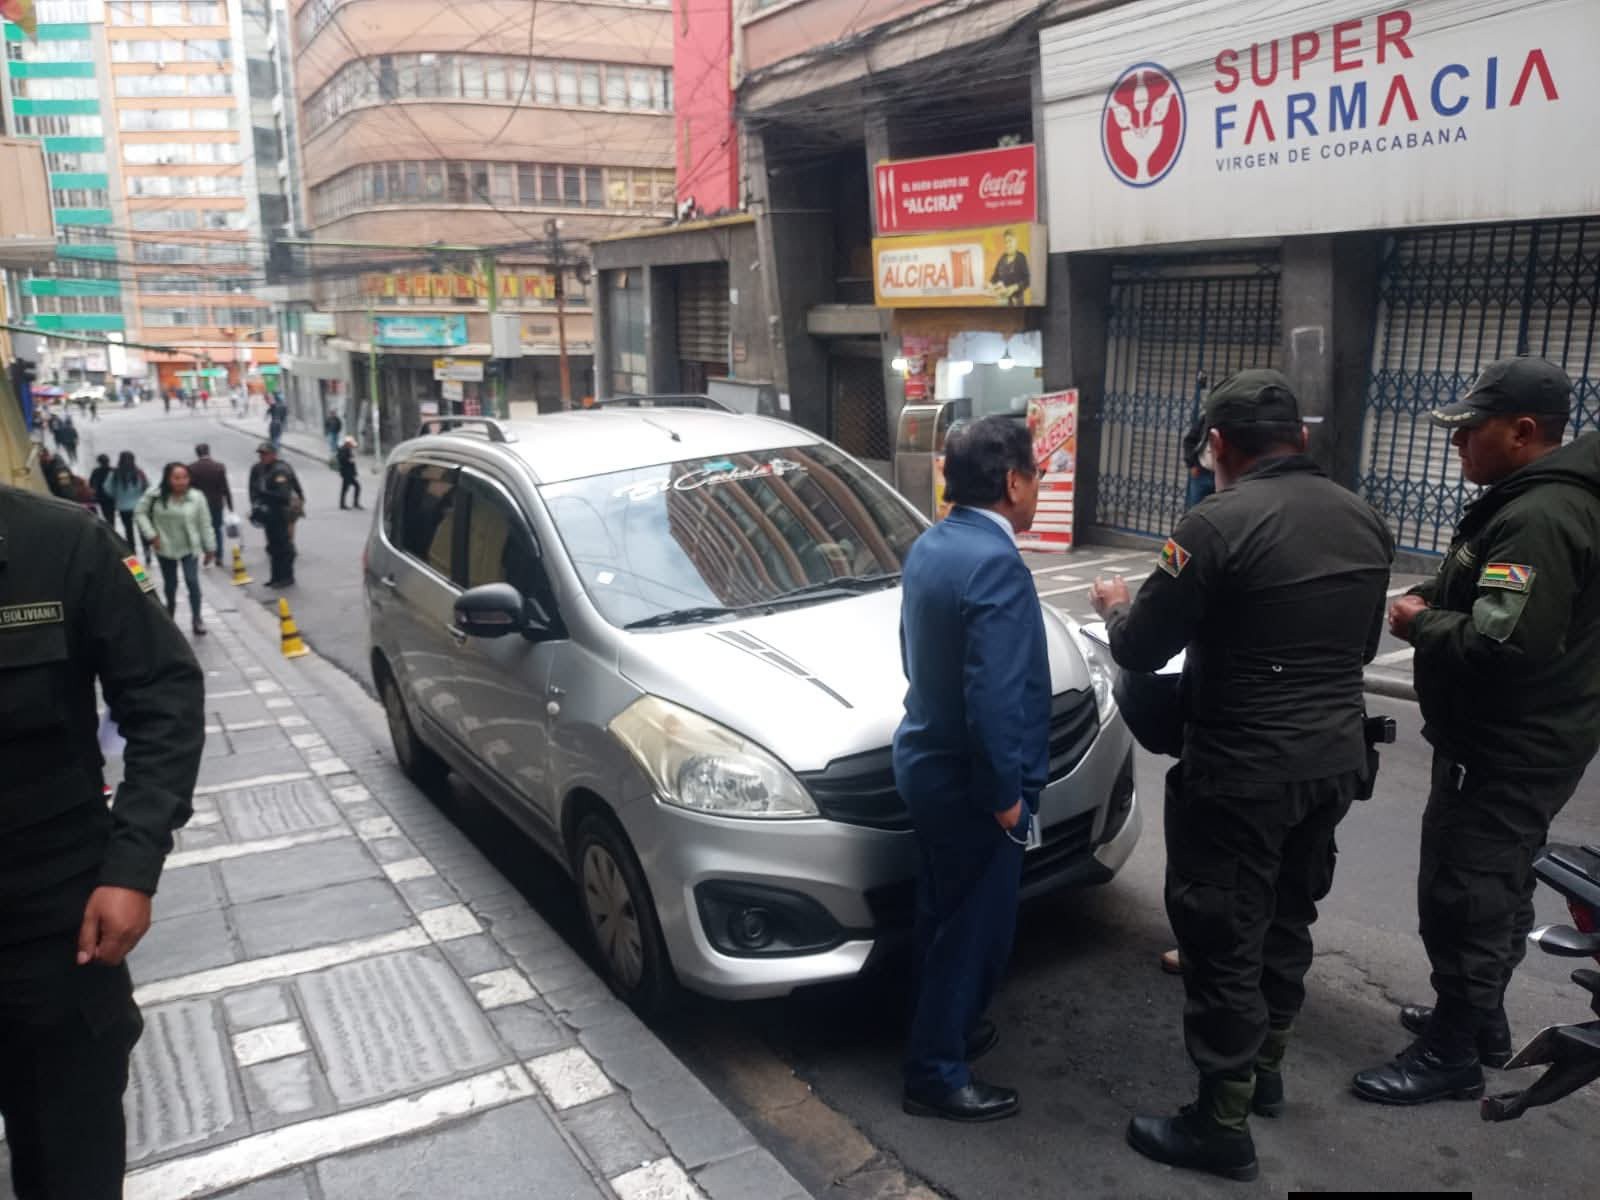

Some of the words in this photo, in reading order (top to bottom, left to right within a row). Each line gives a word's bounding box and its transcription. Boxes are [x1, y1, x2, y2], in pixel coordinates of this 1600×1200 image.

[1214, 10, 1414, 94] SUPER
[1215, 48, 1559, 149] FARMACIA
[1216, 151, 1279, 172] VIRGEN
[1288, 147, 1311, 164] DE
[1320, 126, 1468, 159] COPACABANA
[979, 168, 1028, 199] Coca-Cola
[883, 263, 949, 288] ALCIRA
[2, 606, 57, 623] BOLIVIANA
